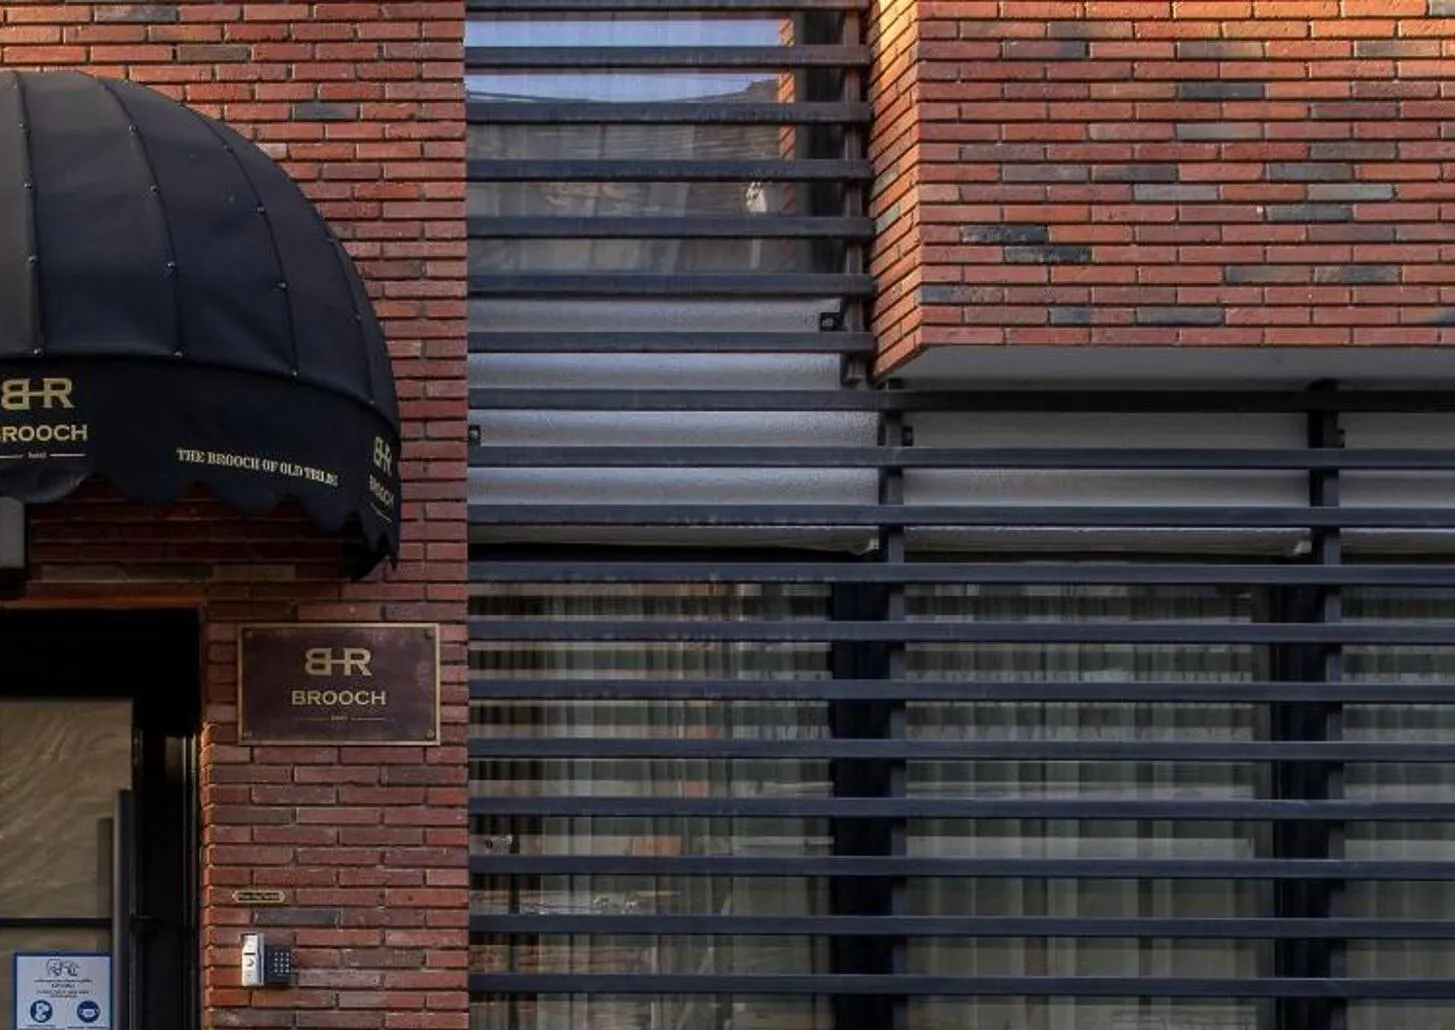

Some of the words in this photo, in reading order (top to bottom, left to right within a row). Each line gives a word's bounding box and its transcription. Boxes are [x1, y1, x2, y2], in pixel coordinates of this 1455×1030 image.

[176, 448, 206, 463] THE
[207, 451, 260, 471] BROOCH
[261, 459, 279, 473] OF
[280, 462, 303, 477] OLD
[291, 689, 387, 706] BROOCH
